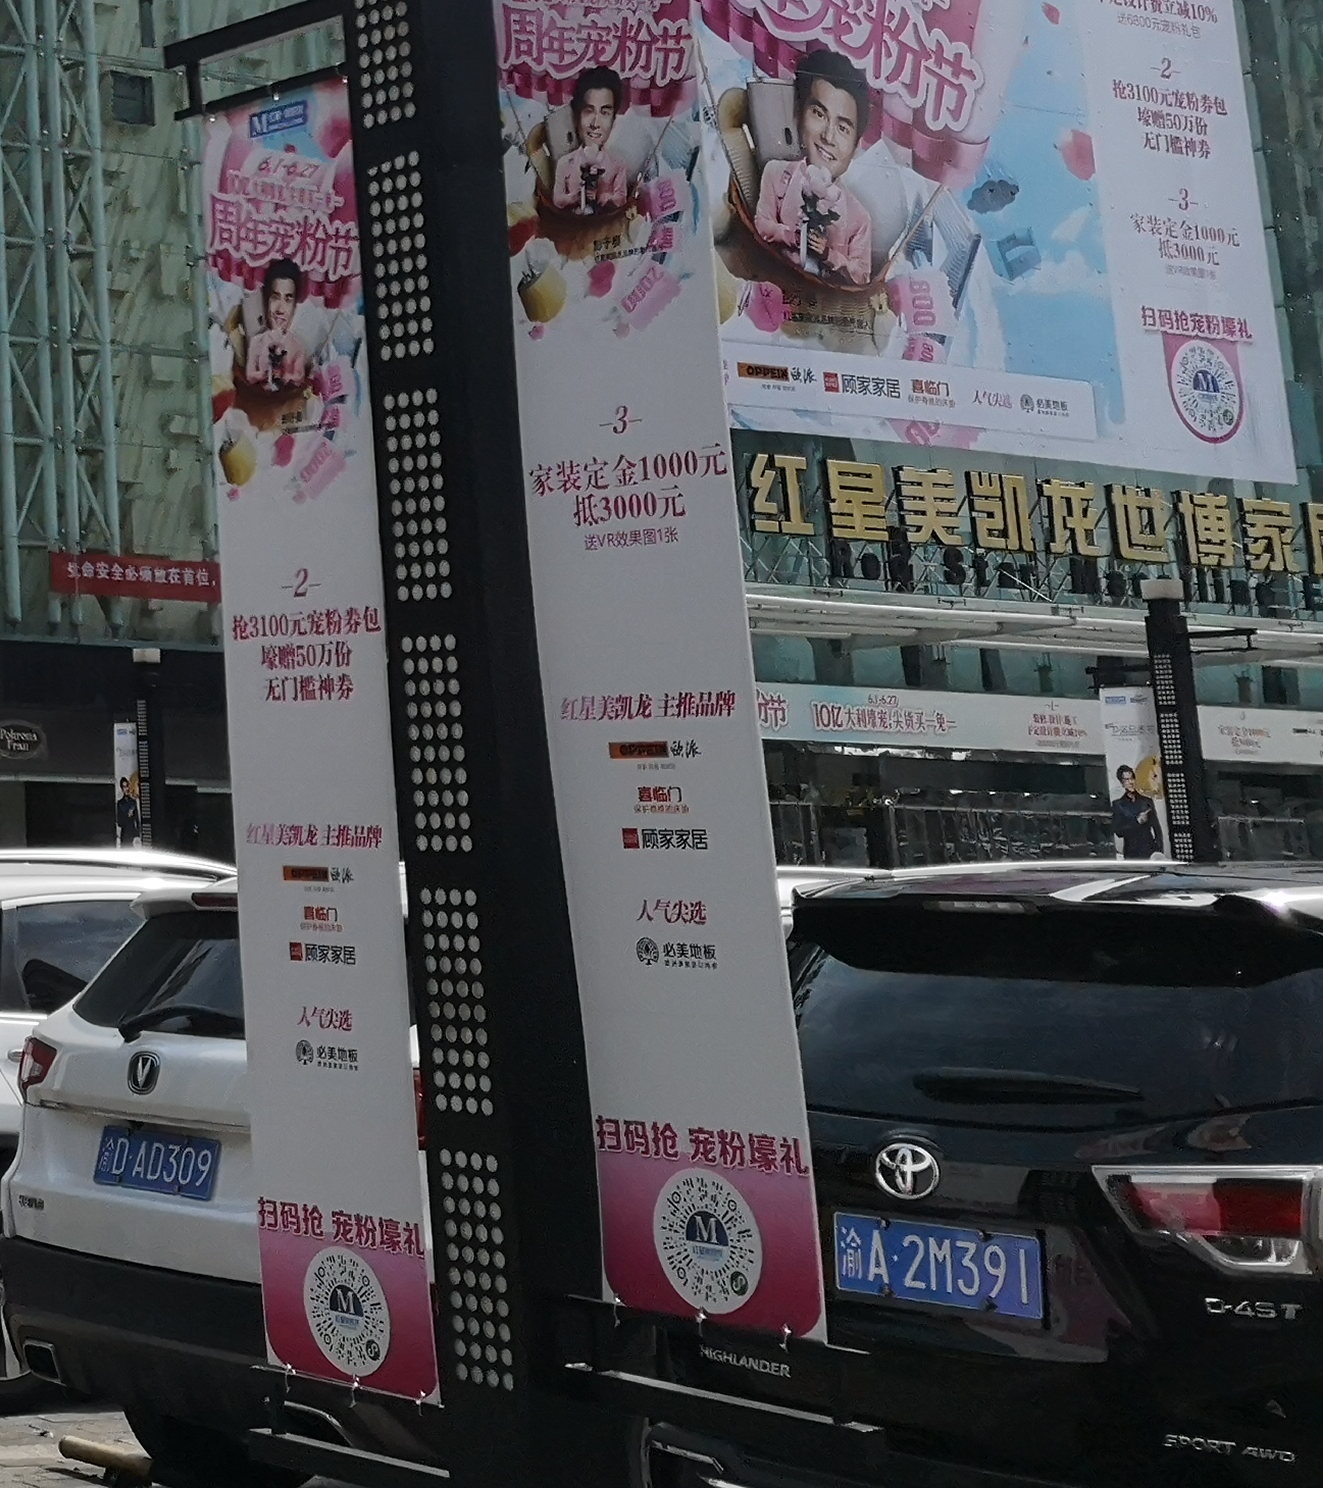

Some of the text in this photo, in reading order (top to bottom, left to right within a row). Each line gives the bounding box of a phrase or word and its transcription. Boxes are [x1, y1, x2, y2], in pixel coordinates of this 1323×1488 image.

[503, 3, 694, 80] 周年宠粉节
[1112, 79, 1228, 117] 抢3100元宠粉券包
[1137, 106, 1208, 136] 壕赠50万份
[1143, 131, 1211, 160] 无门槛神券
[1130, 213, 1241, 248] 家装定金1000元
[1158, 238, 1221, 266] 抵3000元
[746, 365, 789, 381] OPPEIN
[841, 374, 901, 399] 顾家家居
[911, 379, 950, 397] 喜临门
[529, 442, 728, 497] 家装定金1000元
[573, 484, 687, 527] 抵3000元
[584, 525, 679, 551] 送VR效果图1张
[232, 606, 382, 641] 抢3100元宠粉券包
[261, 640, 353, 670] 壕赠50万份
[265, 673, 355, 702] 无门槛神券
[560, 689, 736, 721] 红星美凯龙 主推品牌
[637, 786, 683, 803] 喜临门
[245, 822, 383, 850] 红星美凯龙 主推品牌
[641, 828, 709, 851] 顾家家居
[636, 898, 707, 925] 人气尖选
[304, 943, 356, 965] 顾家家居
[662, 942, 716, 961] 必美地板
[296, 1005, 353, 1032] 人气尖选
[316, 1045, 358, 1063] 必美地板
[595, 1114, 811, 1176] 扫码抢 宠粉壕礼
[258, 1196, 426, 1260] 扫码抢 宠粉壕礼
[700, 1343, 792, 1379] HIGHLANDER
[1161, 1433, 1297, 1463] SPORT AWD
